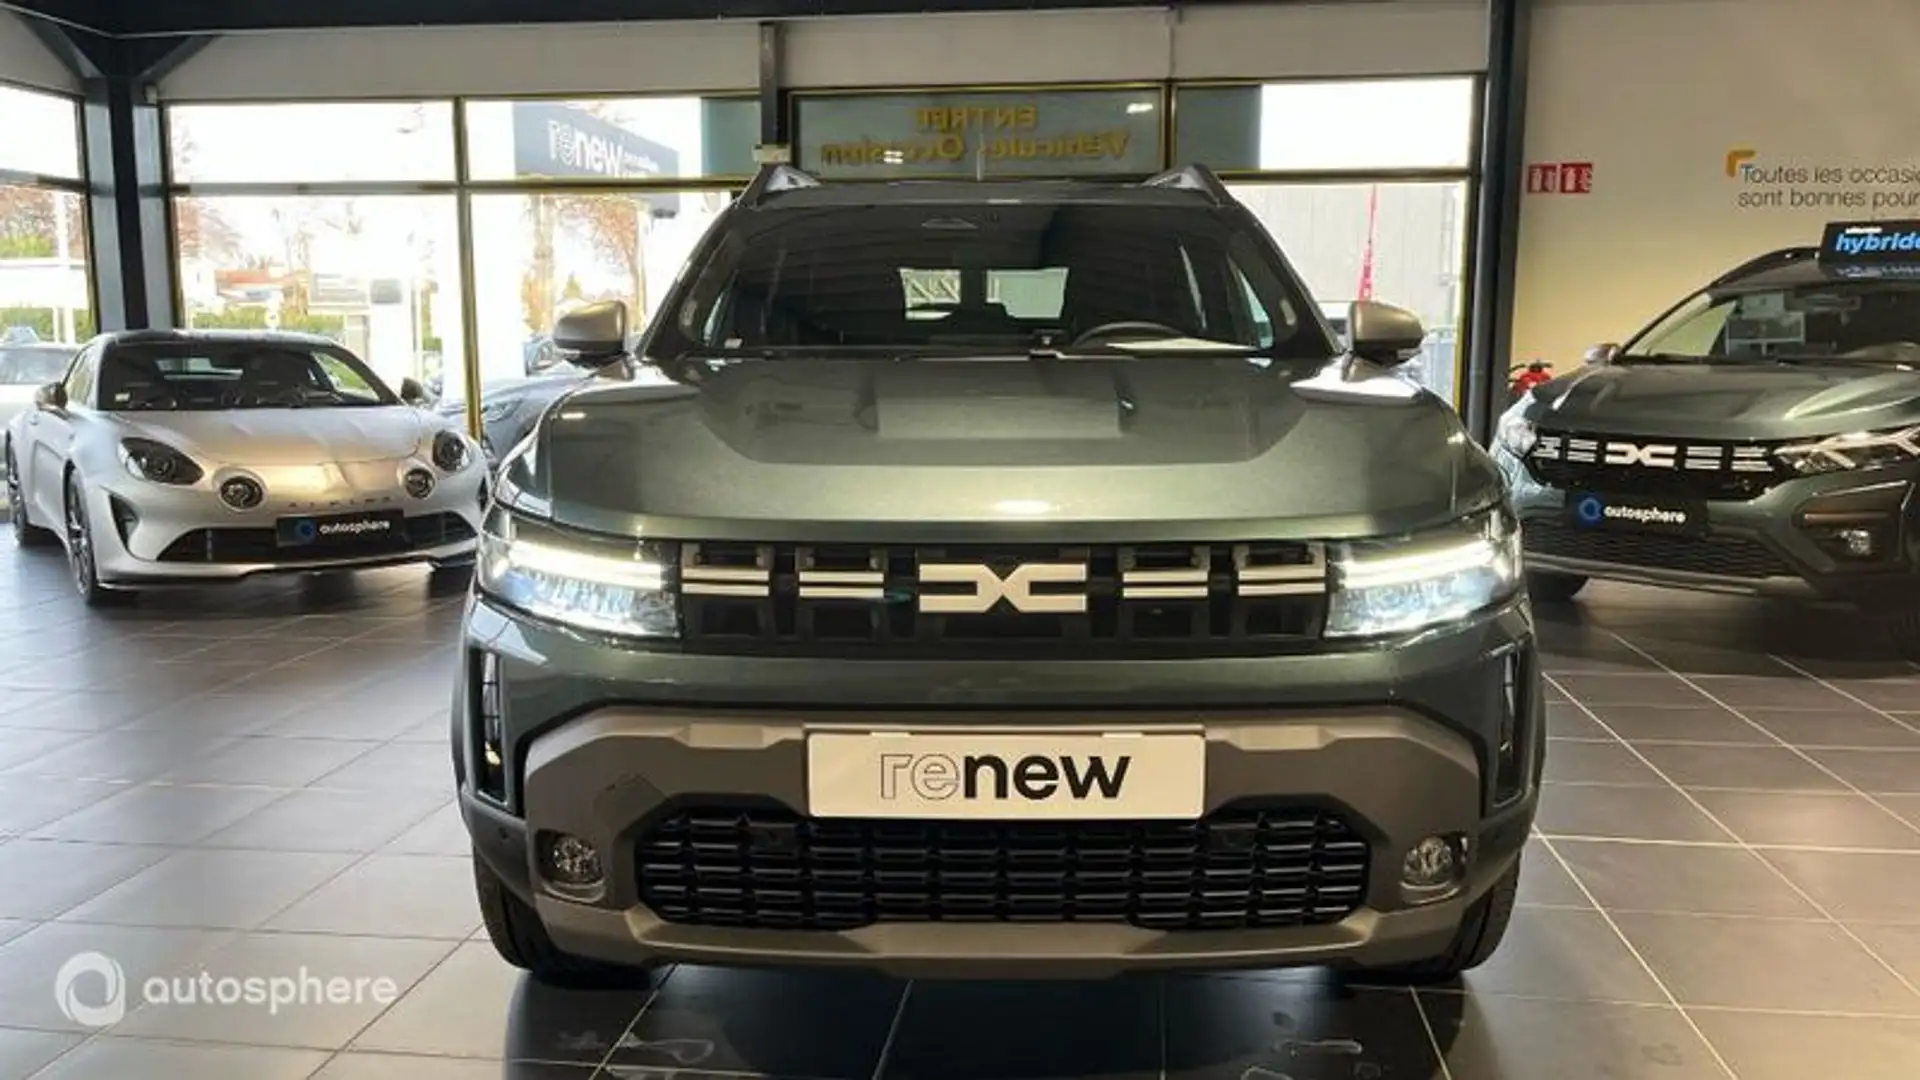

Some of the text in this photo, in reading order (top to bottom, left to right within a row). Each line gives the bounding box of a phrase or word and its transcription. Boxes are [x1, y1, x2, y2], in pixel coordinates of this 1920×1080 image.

[547, 120, 623, 178] renew
[1741, 164, 1808, 183] Toutes
[1813, 166, 1843, 183] les
[1738, 188, 1920, 211] sont bonnes pour
[1603, 506, 1686, 523] autosphere
[319, 519, 391, 535] autosphere
[880, 753, 1132, 800] renew
